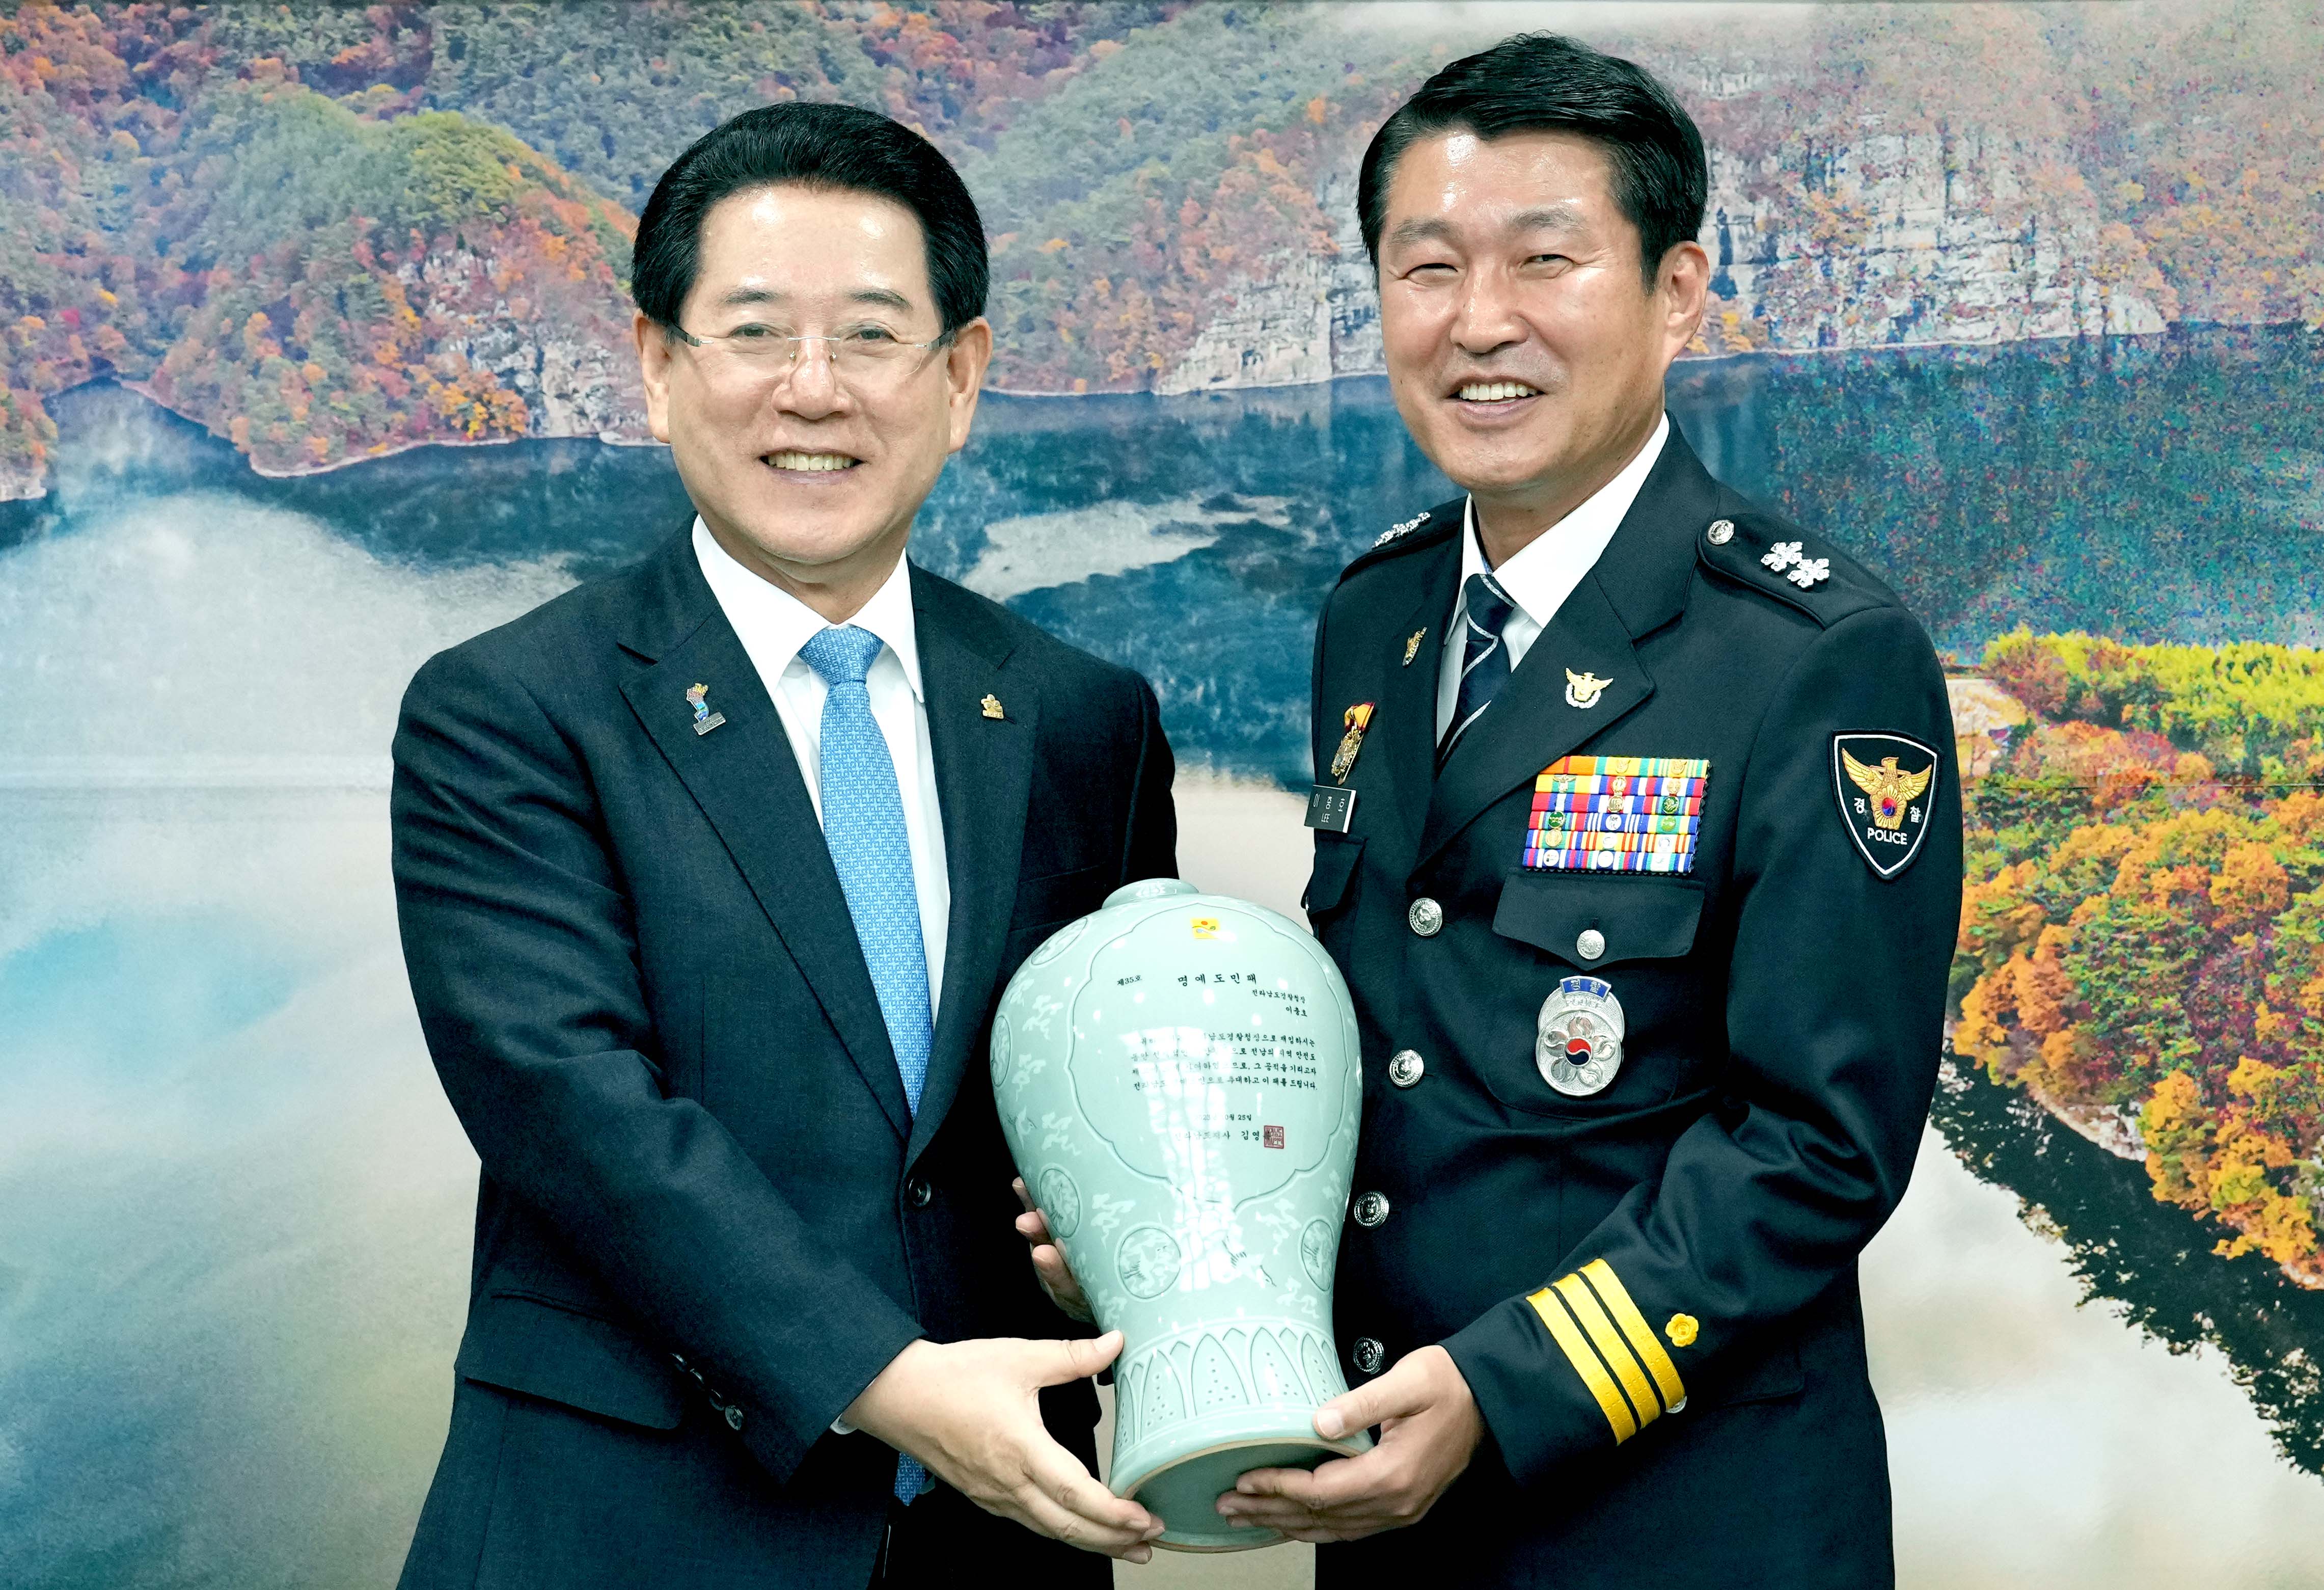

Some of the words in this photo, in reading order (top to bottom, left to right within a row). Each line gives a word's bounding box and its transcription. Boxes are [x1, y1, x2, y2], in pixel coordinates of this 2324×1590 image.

[1867, 827, 1907, 845] POLICE
[1117, 975, 1142, 986] 제35호
[1252, 989, 1305, 1004] 전라남도경찰청장
[1204, 1033, 1277, 1042] 남도경찰청장으로
[1281, 1035, 1315, 1047] 재임하시는
[1251, 1047, 1273, 1056] 전남의
[1296, 1051, 1316, 1060] 안전도
[1265, 1063, 1287, 1072] 공적을
[1290, 1065, 1316, 1076] 기리고자
[1263, 1076, 1269, 1085] 이
[1273, 1077, 1287, 1087] 패를
[1290, 1080, 1318, 1090] 드립니다.
